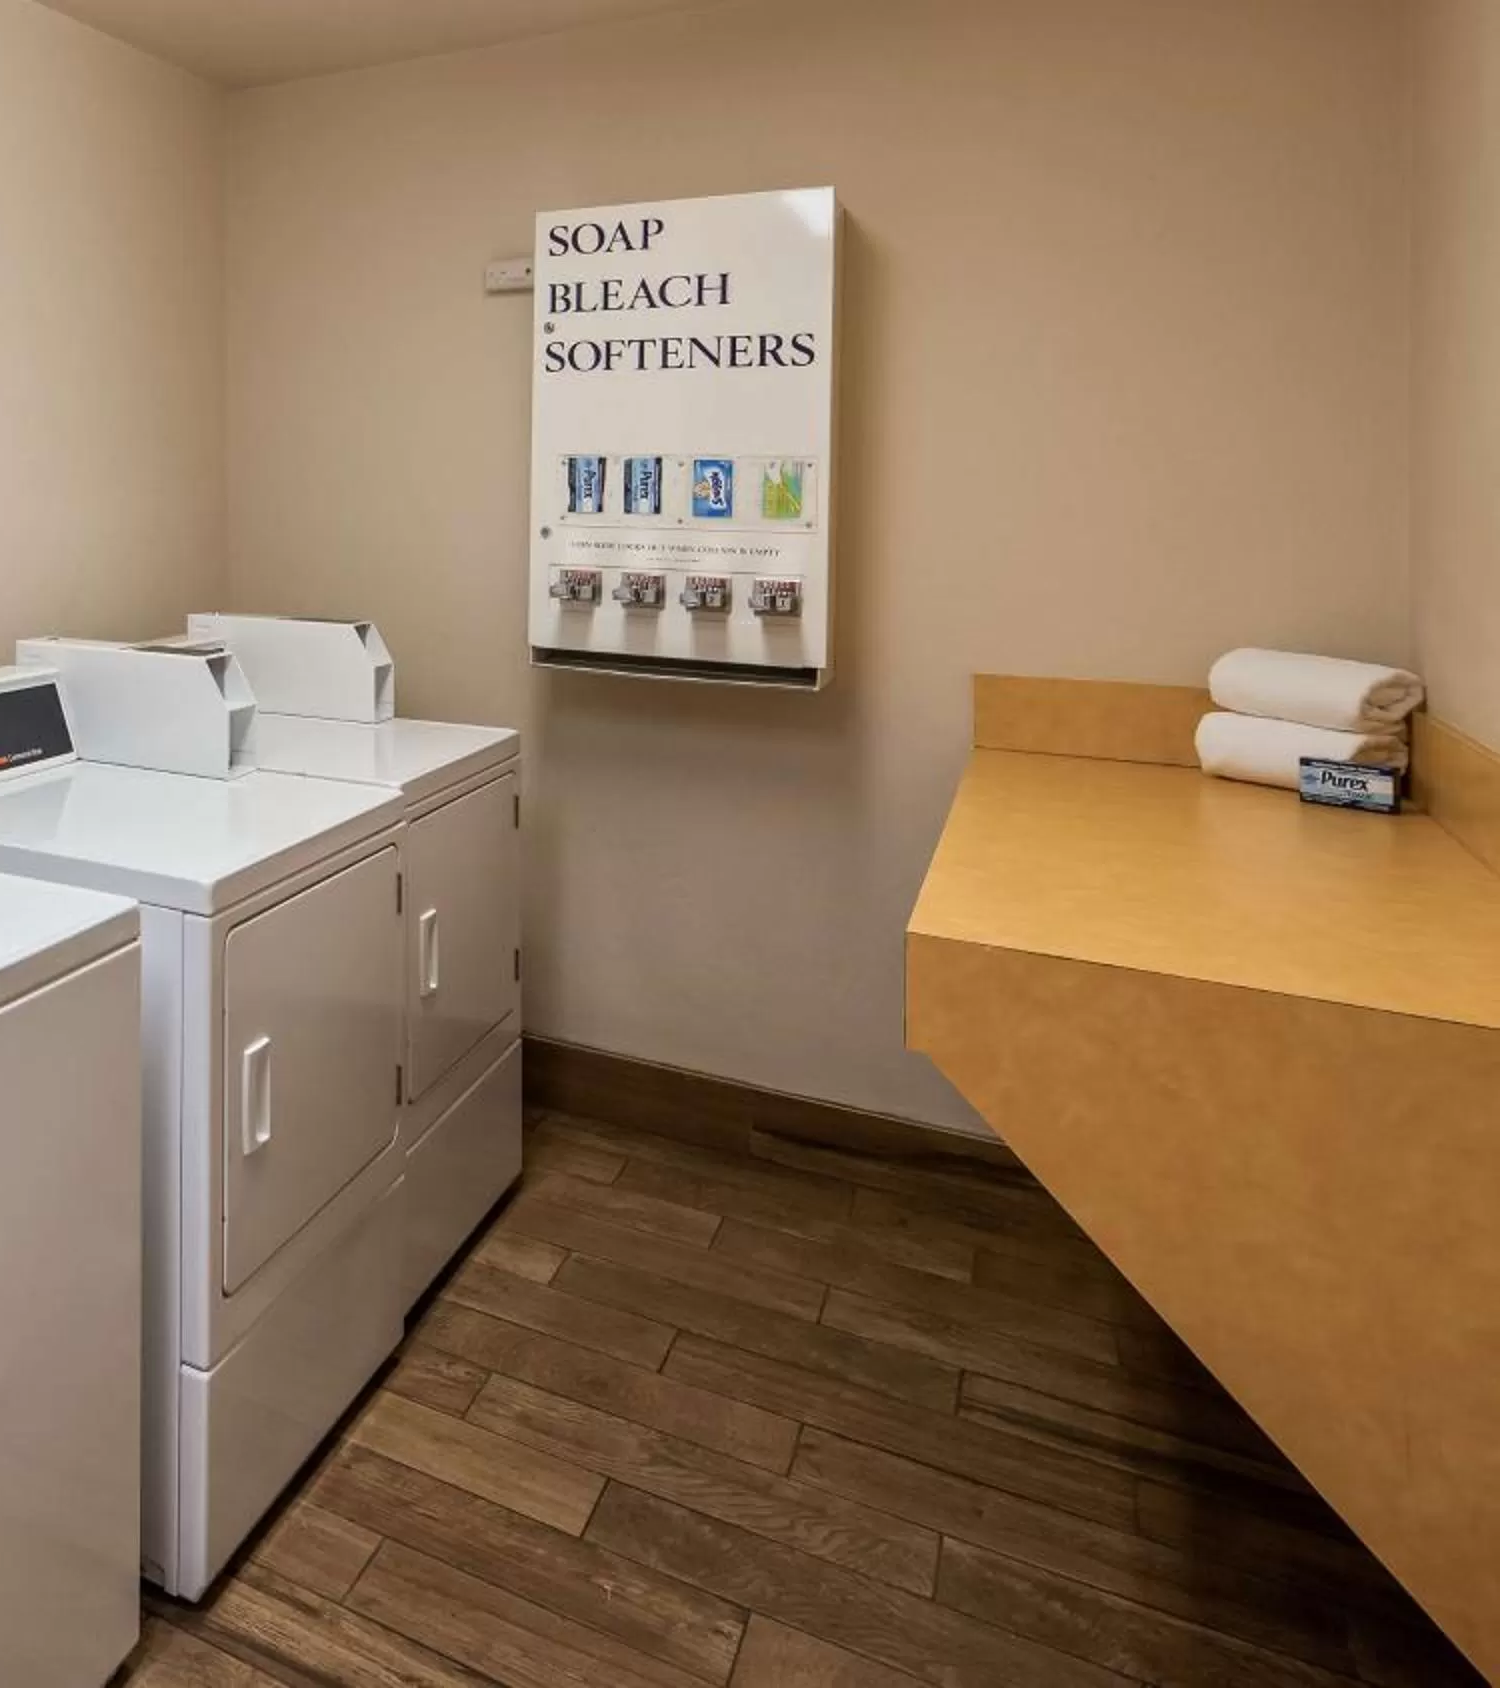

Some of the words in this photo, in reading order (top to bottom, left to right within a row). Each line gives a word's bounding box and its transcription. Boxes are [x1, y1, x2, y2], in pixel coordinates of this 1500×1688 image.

[548, 219, 665, 257] SOAP
[548, 272, 732, 314] BLEACH
[544, 333, 816, 373] SOFTENERS
[1320, 769, 1369, 792] Purex
